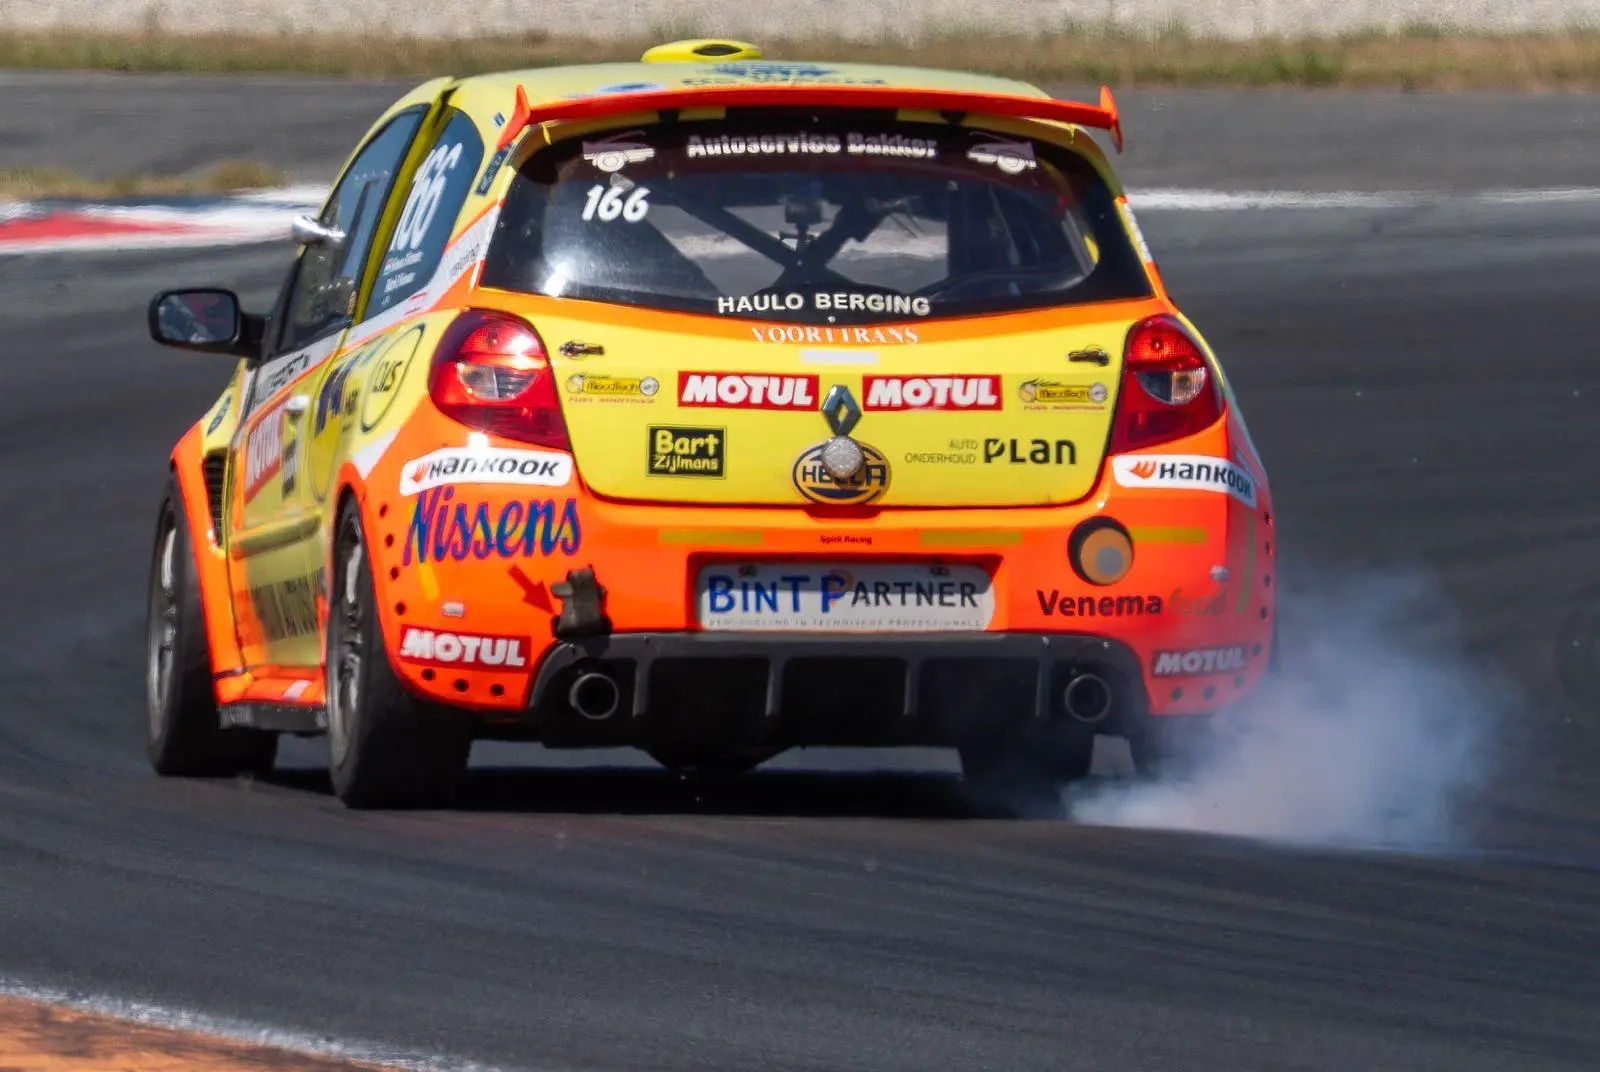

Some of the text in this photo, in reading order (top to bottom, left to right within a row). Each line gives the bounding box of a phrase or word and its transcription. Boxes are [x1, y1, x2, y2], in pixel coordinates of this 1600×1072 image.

[687, 131, 936, 159] Autoservice Bakker
[582, 184, 651, 223] 166
[717, 293, 931, 315] HAULO BERGING
[681, 374, 813, 406] MOTUL
[866, 376, 997, 407] MOTUL
[655, 430, 719, 456] Bart
[949, 440, 978, 450] AUTO
[654, 456, 718, 473] Zijlmans
[904, 453, 976, 464] ONDERHOUD
[403, 485, 581, 566] Nissens
[820, 534, 872, 545] Spirit Racing
[1037, 589, 1163, 617] Venema
[400, 628, 526, 667] MOTUL
[1155, 647, 1244, 676] MOTUL
